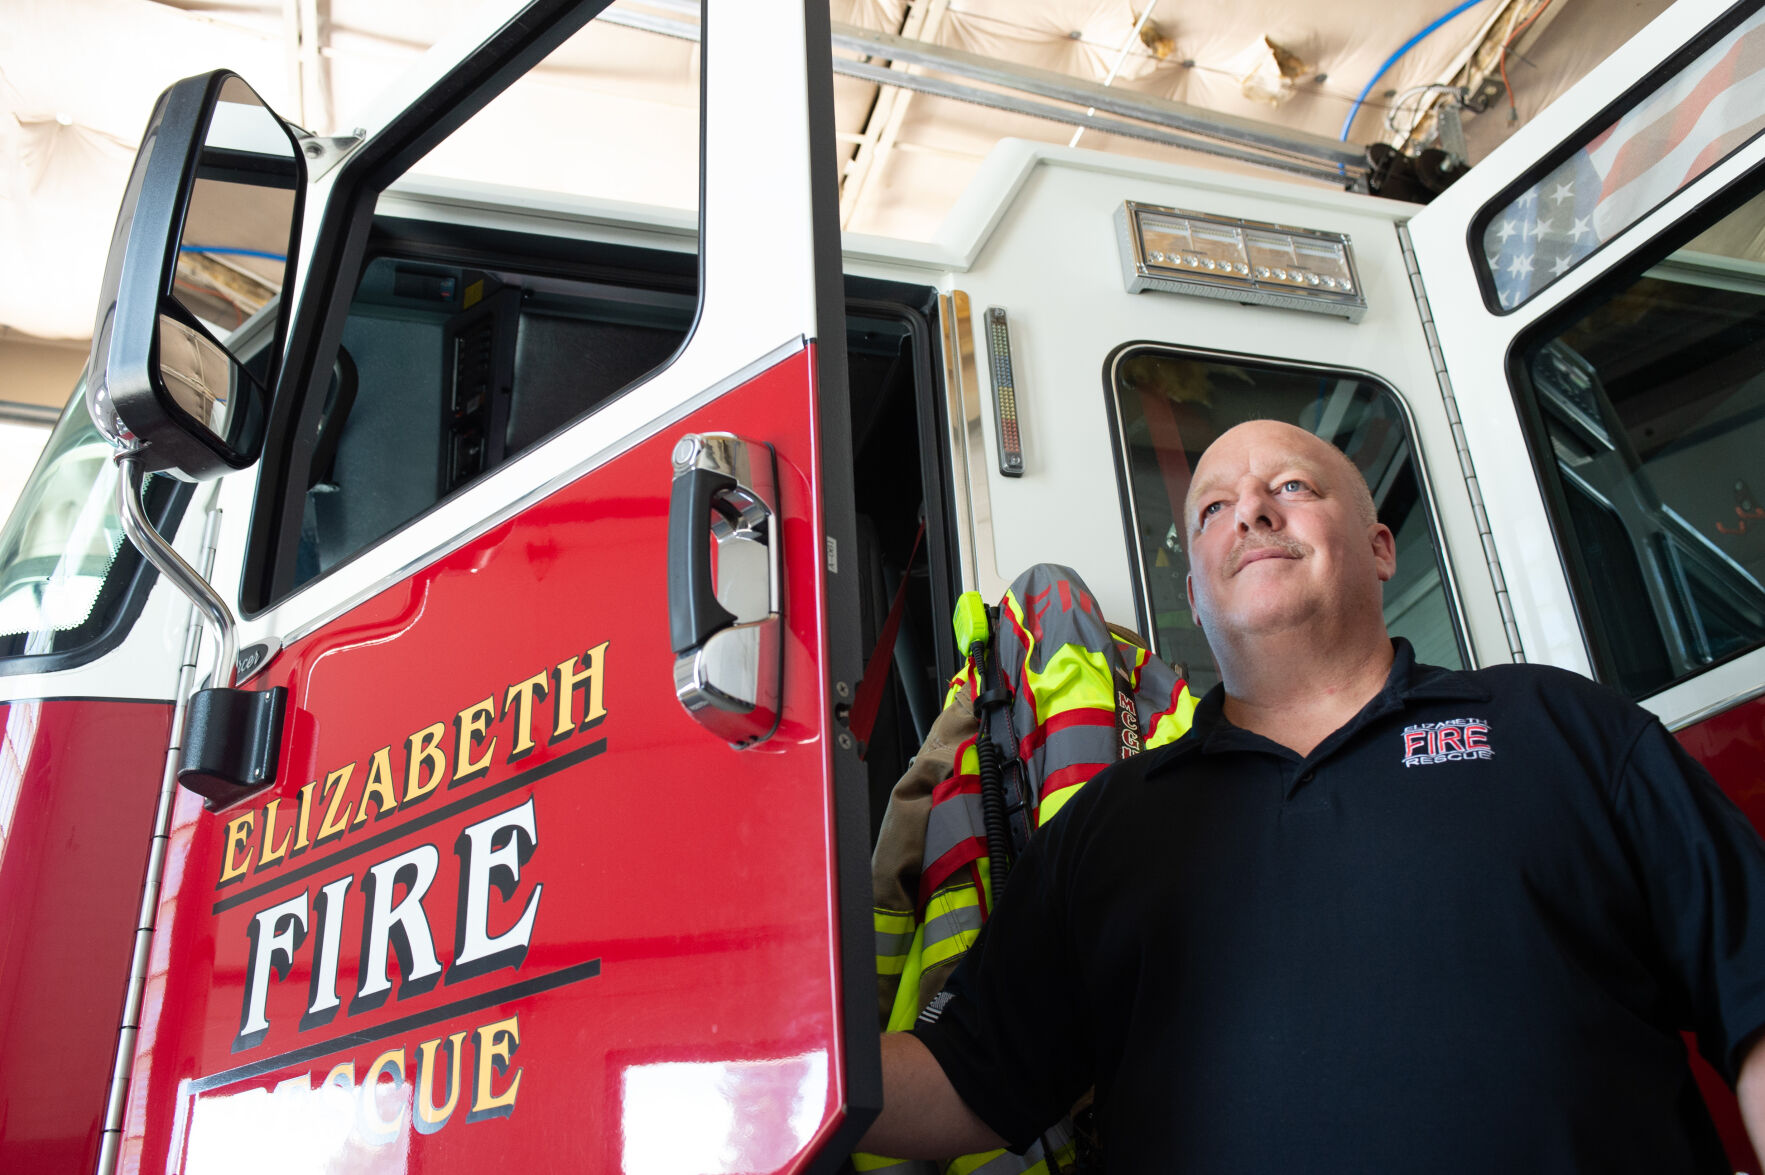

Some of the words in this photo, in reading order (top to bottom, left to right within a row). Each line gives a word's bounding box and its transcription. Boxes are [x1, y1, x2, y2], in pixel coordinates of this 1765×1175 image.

[217, 640, 611, 889] ELIZABETH
[1404, 725, 1491, 758] FIRE
[1405, 751, 1493, 768] RESCUE
[232, 794, 544, 1053] FIRE
